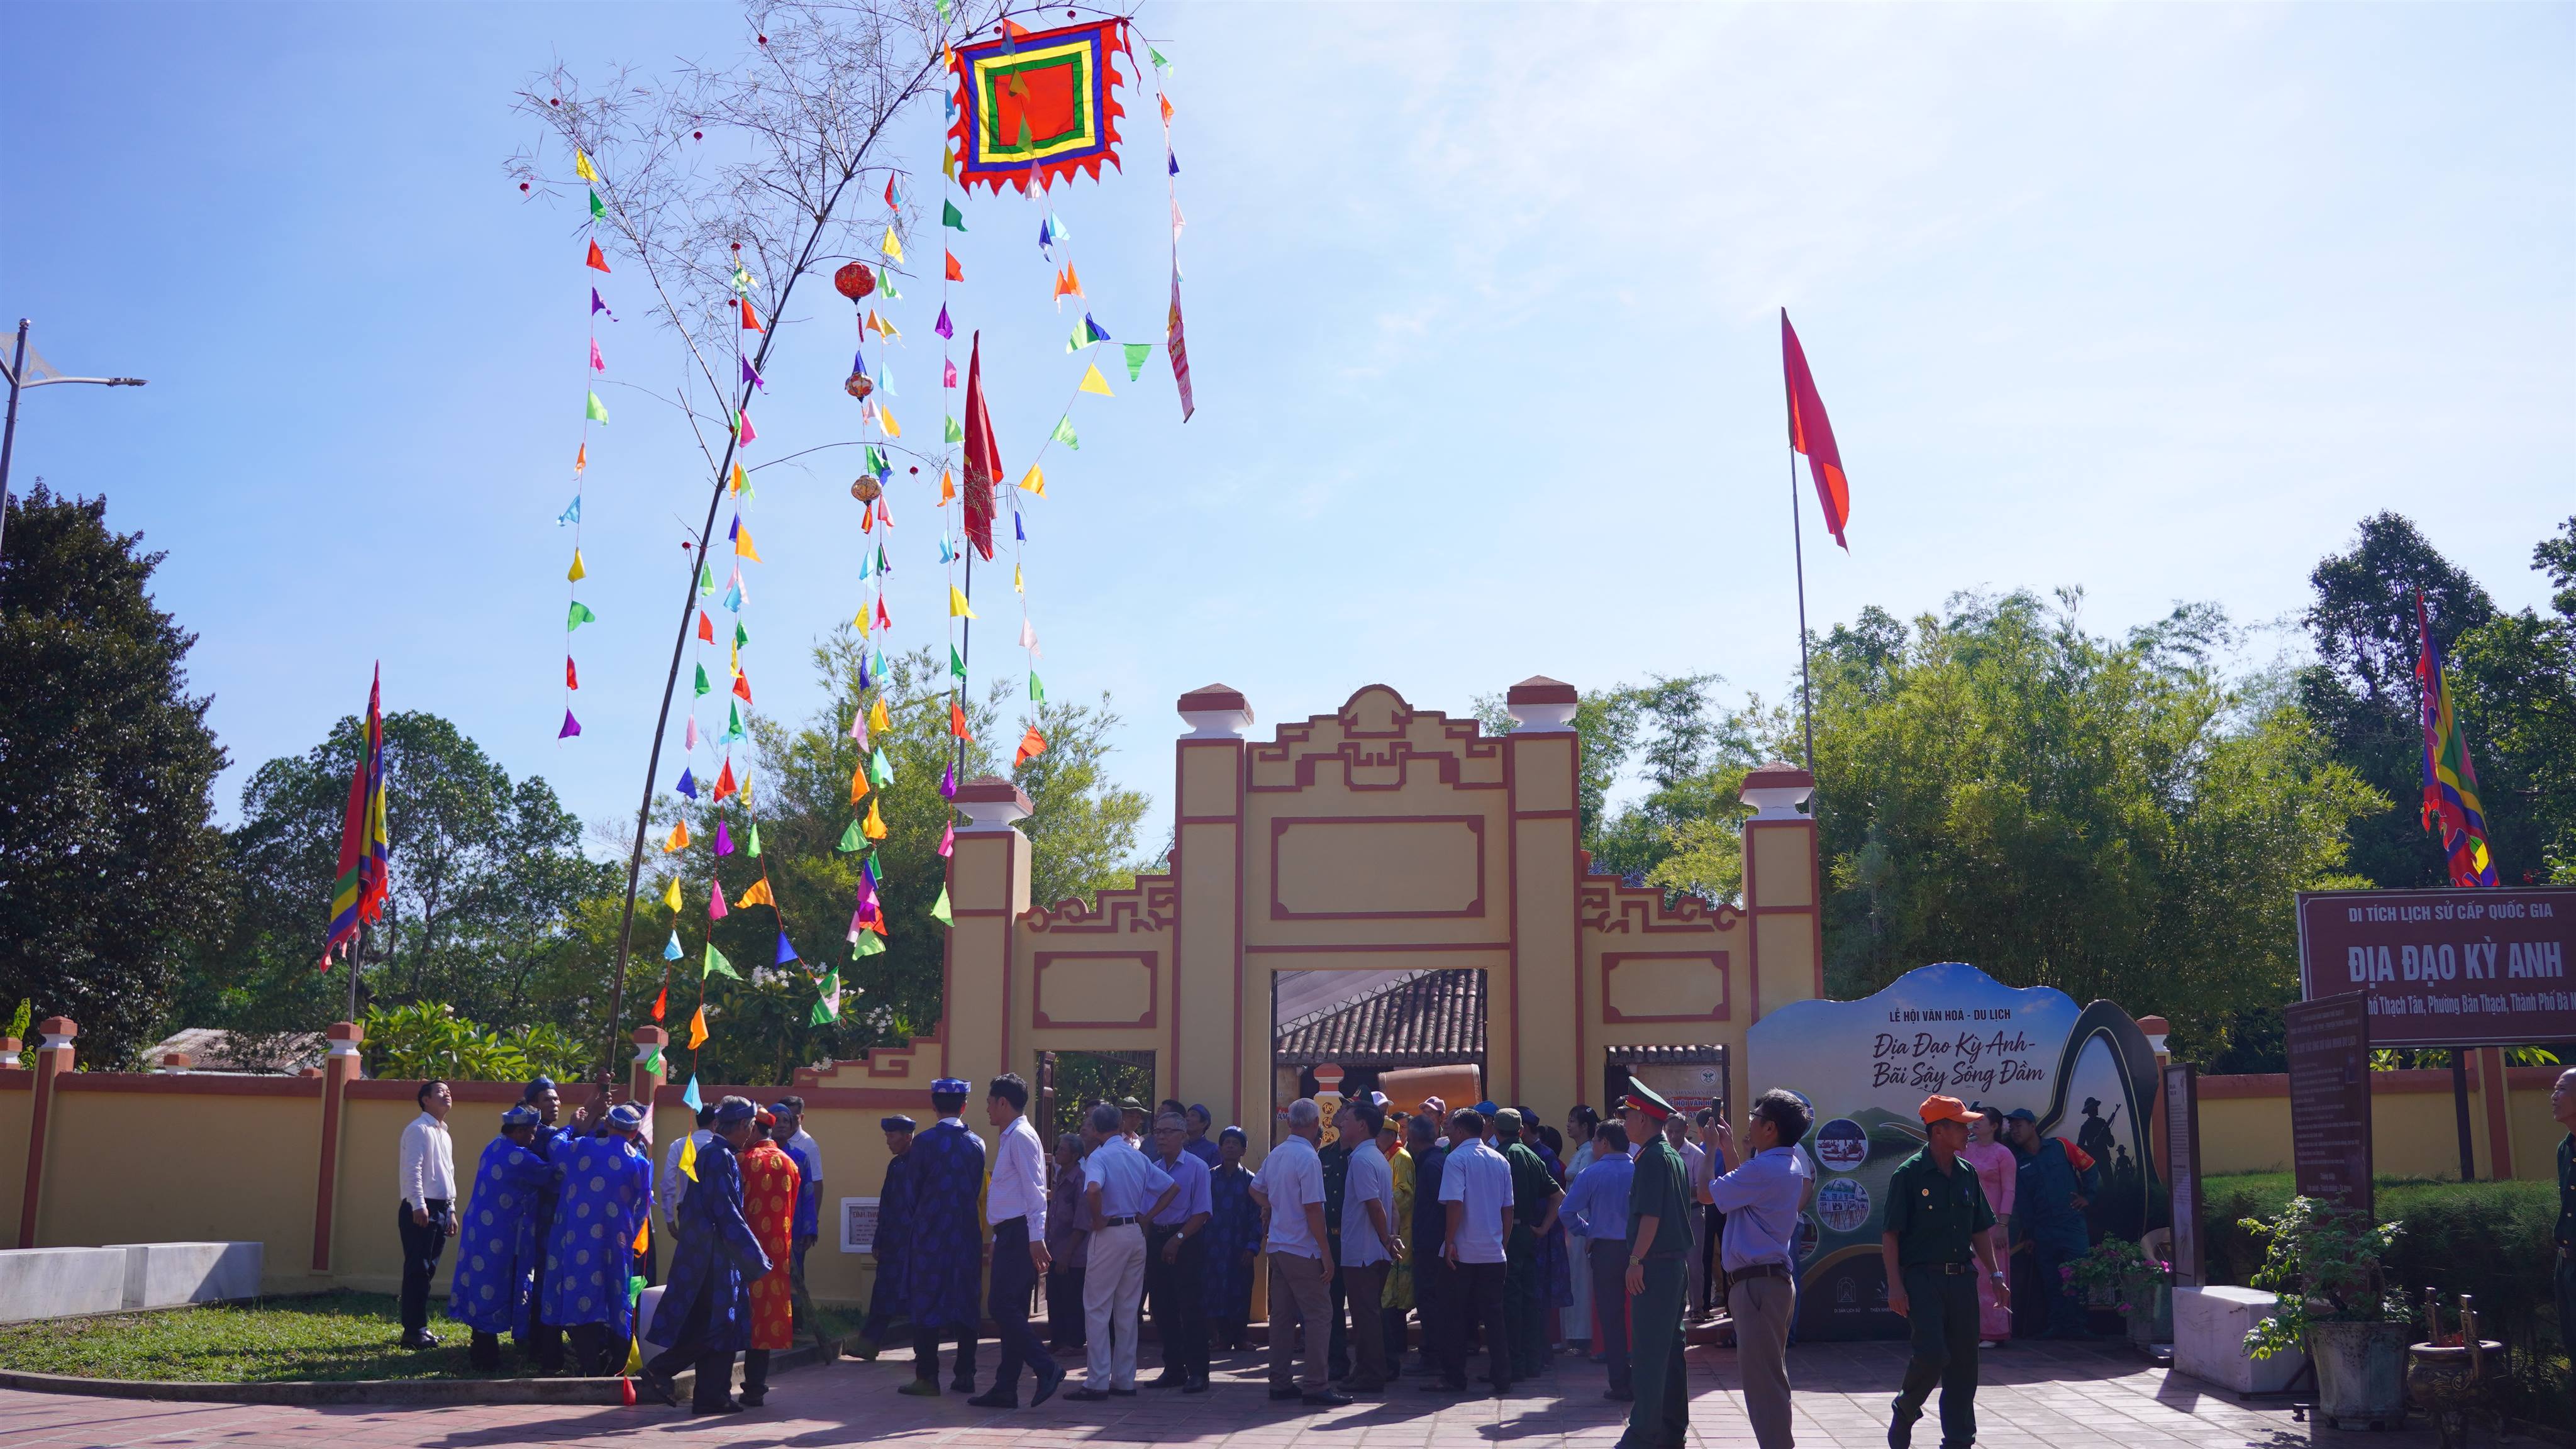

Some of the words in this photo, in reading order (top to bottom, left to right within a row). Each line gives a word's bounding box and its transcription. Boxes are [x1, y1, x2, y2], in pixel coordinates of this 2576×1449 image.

[2348, 908, 2363, 922] DI
[2365, 904, 2397, 921] TÍCH
[2400, 906, 2431, 923] LỊCH
[2434, 900, 2454, 920] SỬ
[2457, 900, 2484, 919] CẤP
[2488, 899, 2525, 920] QUỐC
[2529, 902, 2553, 918] GIA
[2348, 945, 2395, 989] ĐỊA
[2401, 943, 2456, 987] ĐẠO
[2463, 935, 2497, 979] KỲ
[2508, 941, 2563, 978] ANH
[1889, 1007, 1901, 1023] LỄ
[1903, 1009, 1920, 1024] HỘI
[1922, 1008, 1942, 1022] VĂN
[1974, 1009, 1987, 1021] DU
[1989, 1009, 2011, 1022] LỊCH
[2367, 994, 2379, 1015] hố
[2379, 996, 2406, 1017] Thạch
[2407, 995, 2426, 1016] Tân,
[2428, 994, 2460, 1015] Phường
[2462, 992, 2479, 1013] Bàn
[2480, 994, 2509, 1015] Thạch,
[2510, 992, 2536, 1012] Thành
[2538, 989, 2555, 1011] Phố
[1872, 1033, 1910, 1060] Địa
[1912, 1032, 1951, 1059] Đạo
[1955, 1031, 1984, 1063] Kỳ
[1872, 1061, 1908, 1088] Bãi
[1910, 1061, 1949, 1094] Sậy
[1951, 1060, 1997, 1093] Sông
[1999, 1059, 2045, 1085] Đầm
